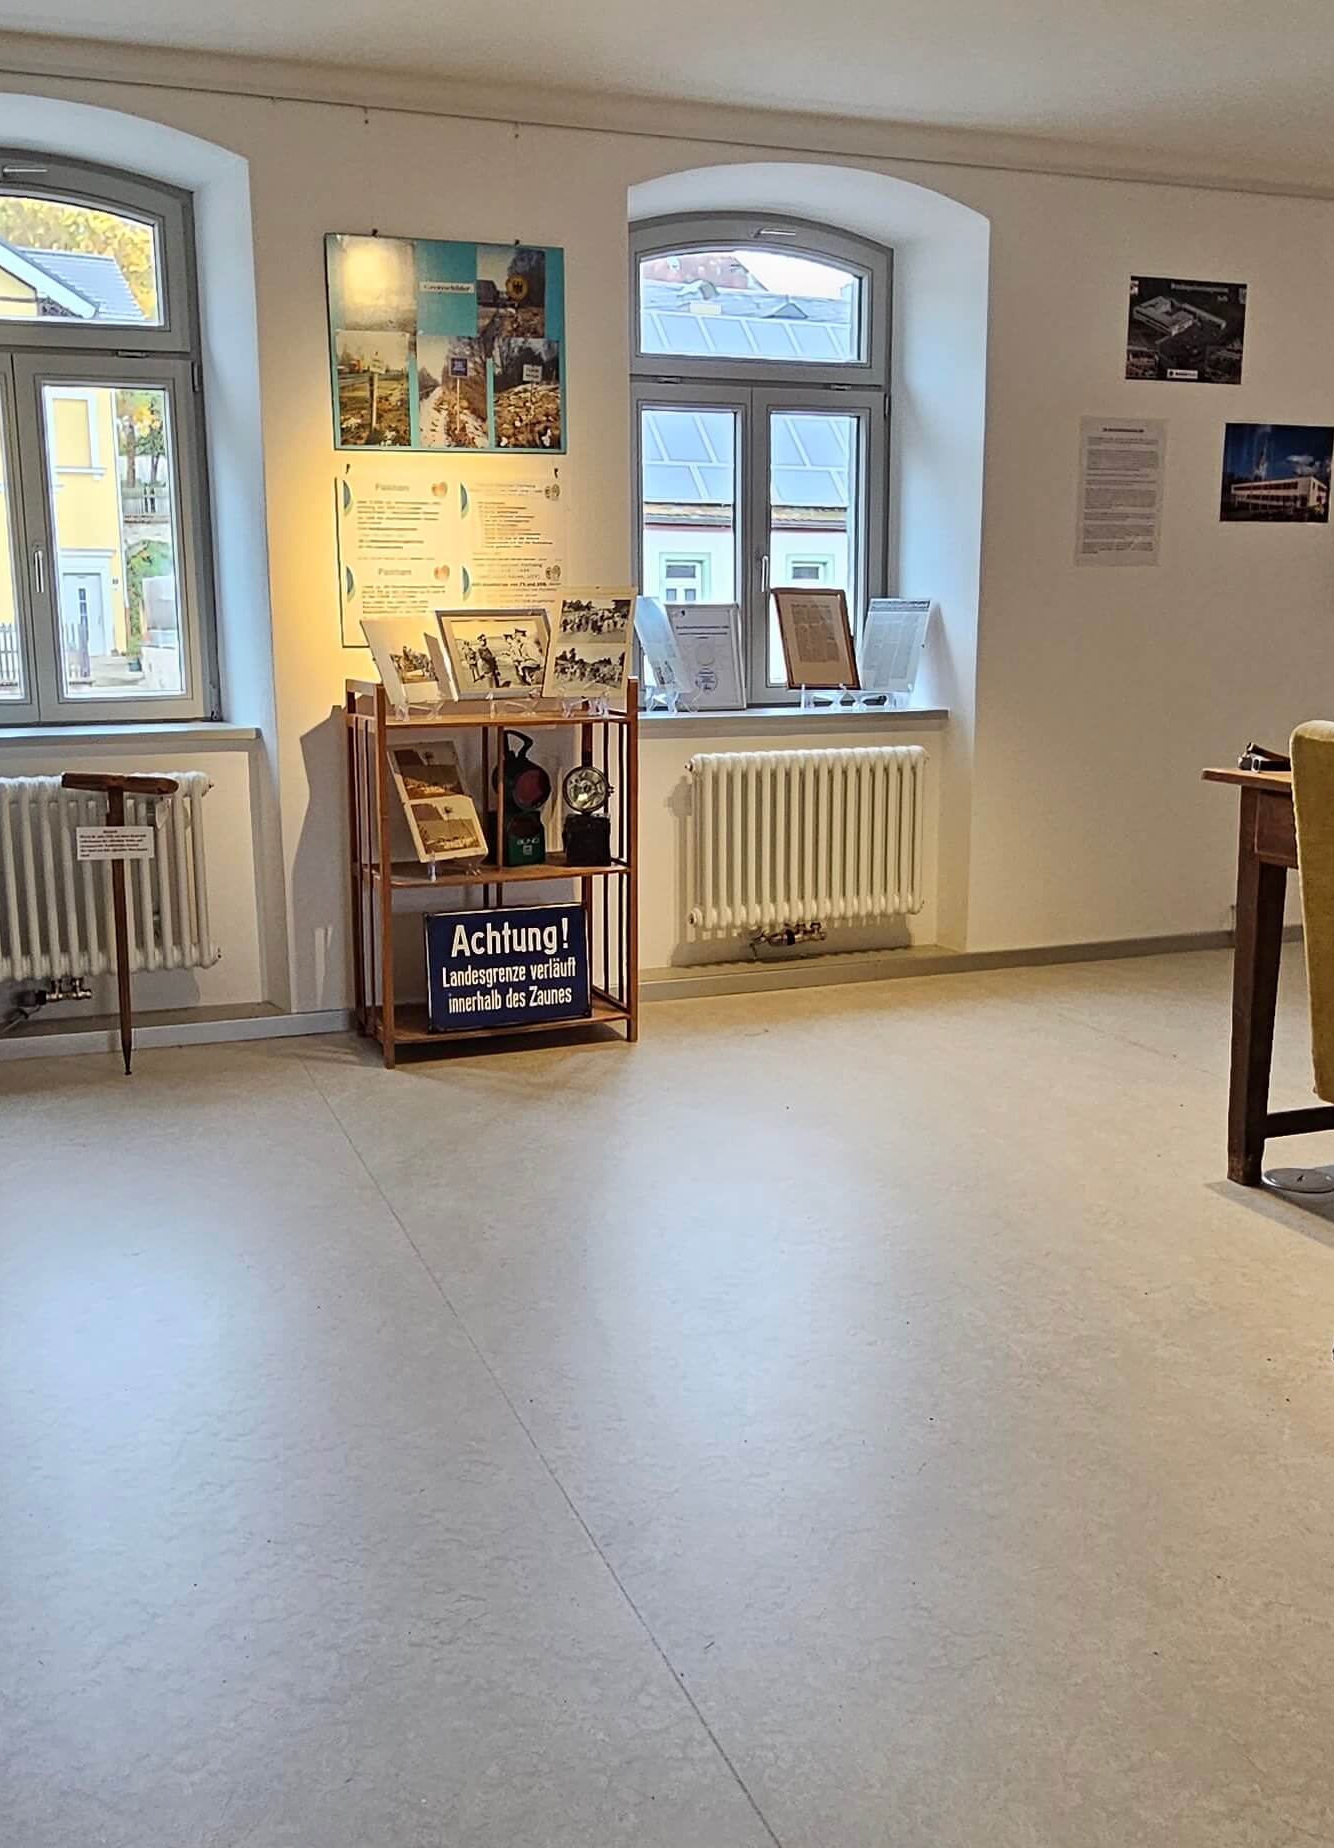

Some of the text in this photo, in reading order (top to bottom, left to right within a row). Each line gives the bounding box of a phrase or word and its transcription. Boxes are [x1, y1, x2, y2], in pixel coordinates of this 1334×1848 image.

[451, 918, 569, 958] Achtung!
[442, 957, 576, 988] Landesgrenze verläuft
[449, 985, 572, 1014] innerhalb des Zaunes
